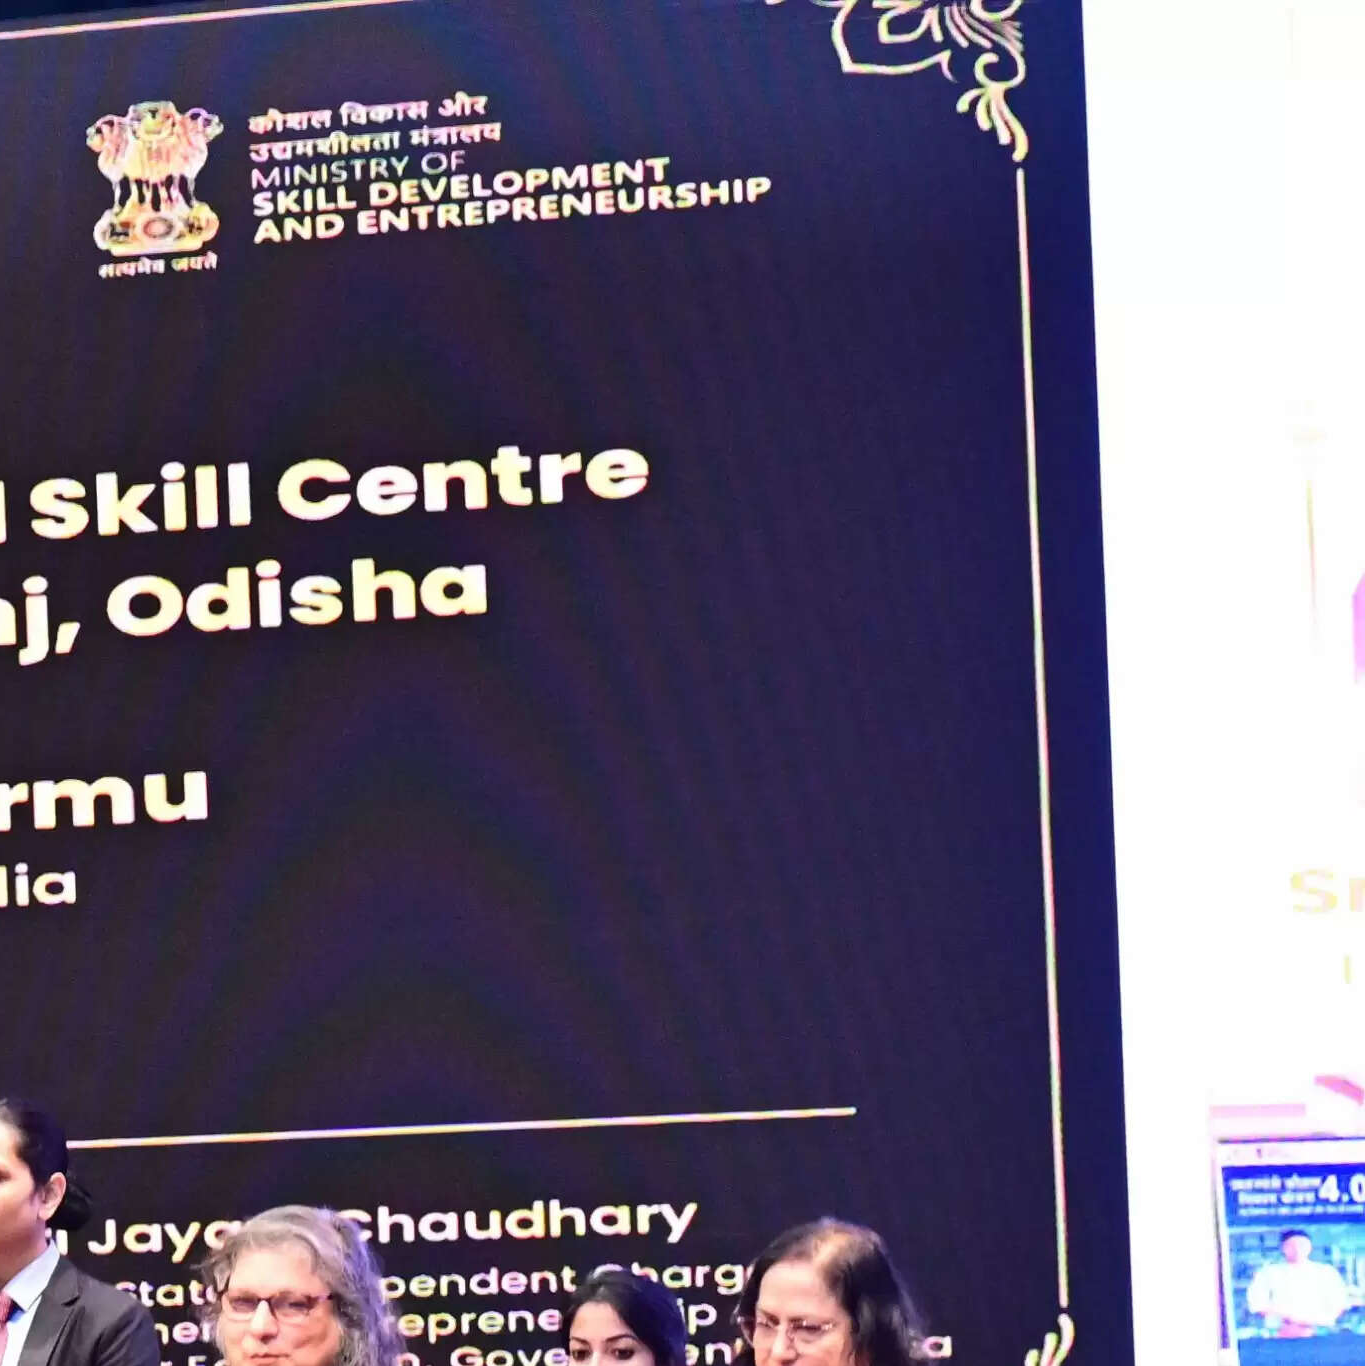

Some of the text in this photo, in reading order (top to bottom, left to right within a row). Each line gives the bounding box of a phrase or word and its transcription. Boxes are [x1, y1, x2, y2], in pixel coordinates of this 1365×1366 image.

[251, 150, 466, 189] MINISTRY OF
[253, 156, 670, 217] SKILL DEVELOPMENT
[254, 176, 771, 244] AND ENTREPRENEURSHIP
[28, 460, 253, 540] Skill
[276, 444, 650, 522] Centre
[105, 556, 489, 638] Odisha
[87, 1218, 243, 1264] Jaya
